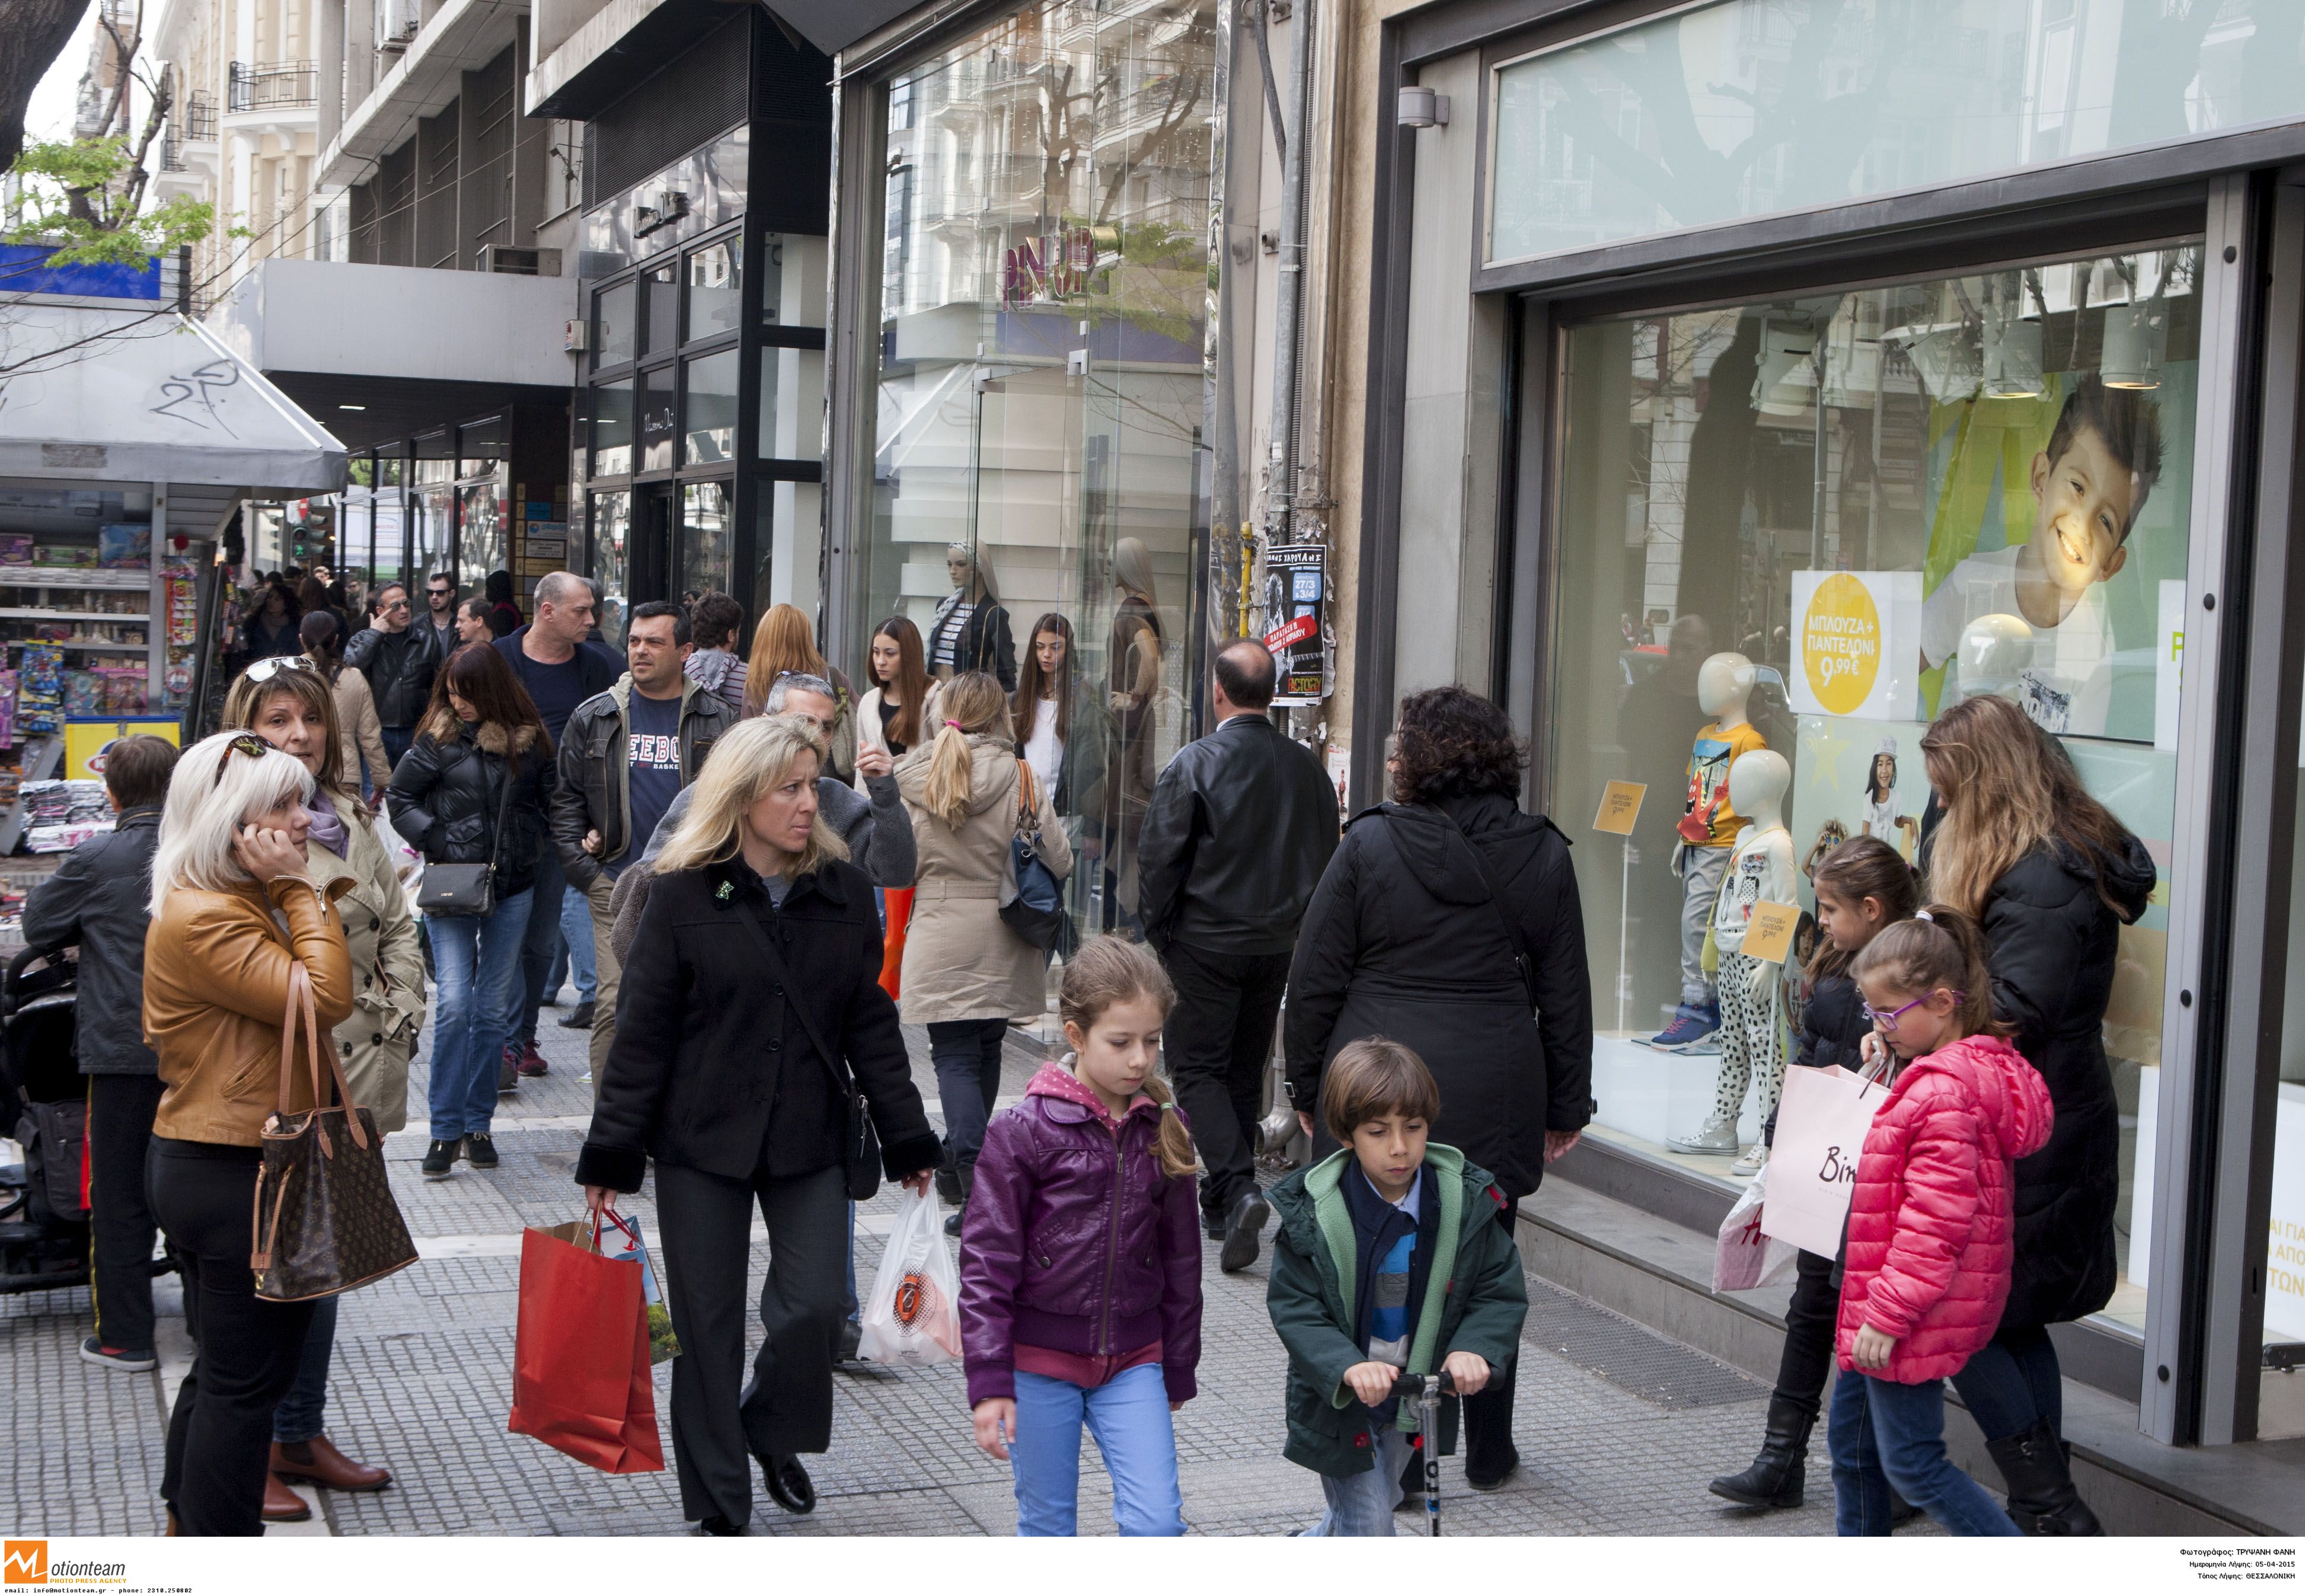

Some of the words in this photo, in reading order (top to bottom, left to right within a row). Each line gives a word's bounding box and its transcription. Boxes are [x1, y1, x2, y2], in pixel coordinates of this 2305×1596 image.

[1295, 580, 1316, 589] 27/3
[1808, 614, 1865, 634] ΜΠΛΟΥΖΑ
[1807, 634, 1875, 656] ΠΑΝΤΕΛΟΝΙ
[1288, 676, 1321, 692] FACTORY
